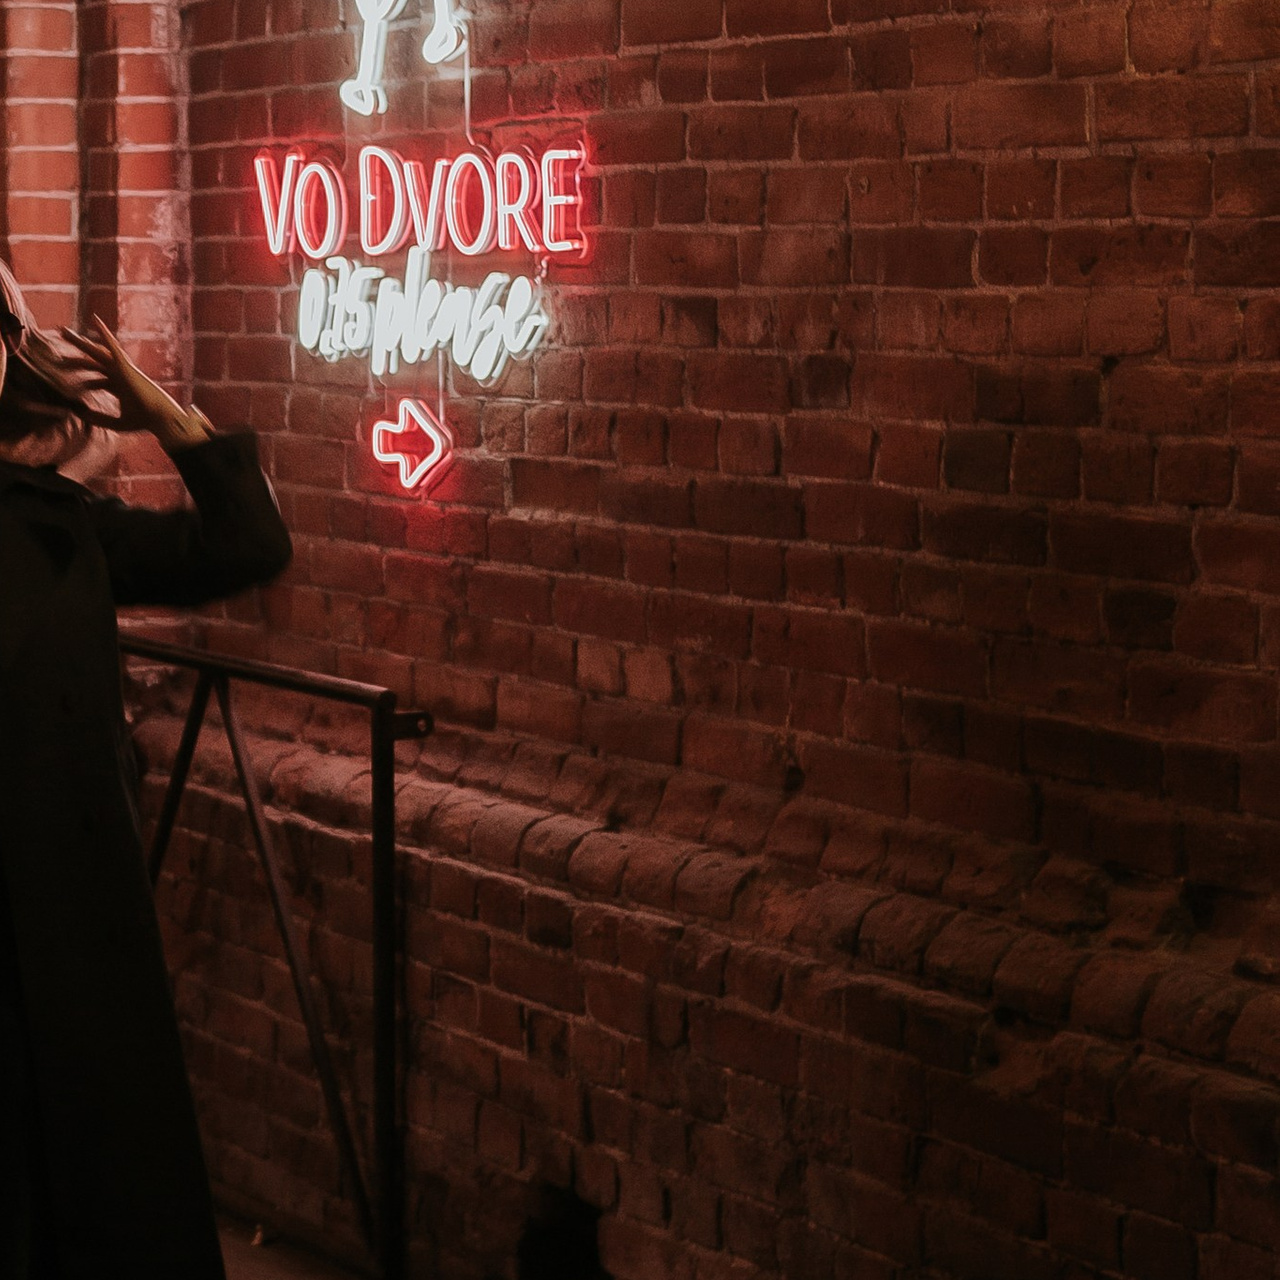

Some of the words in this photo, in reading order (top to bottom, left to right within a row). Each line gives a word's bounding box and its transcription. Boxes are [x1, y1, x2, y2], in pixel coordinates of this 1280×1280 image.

[253, 151, 342, 259] VO
[359, 145, 586, 257] DVORE
[370, 245, 548, 384] please
